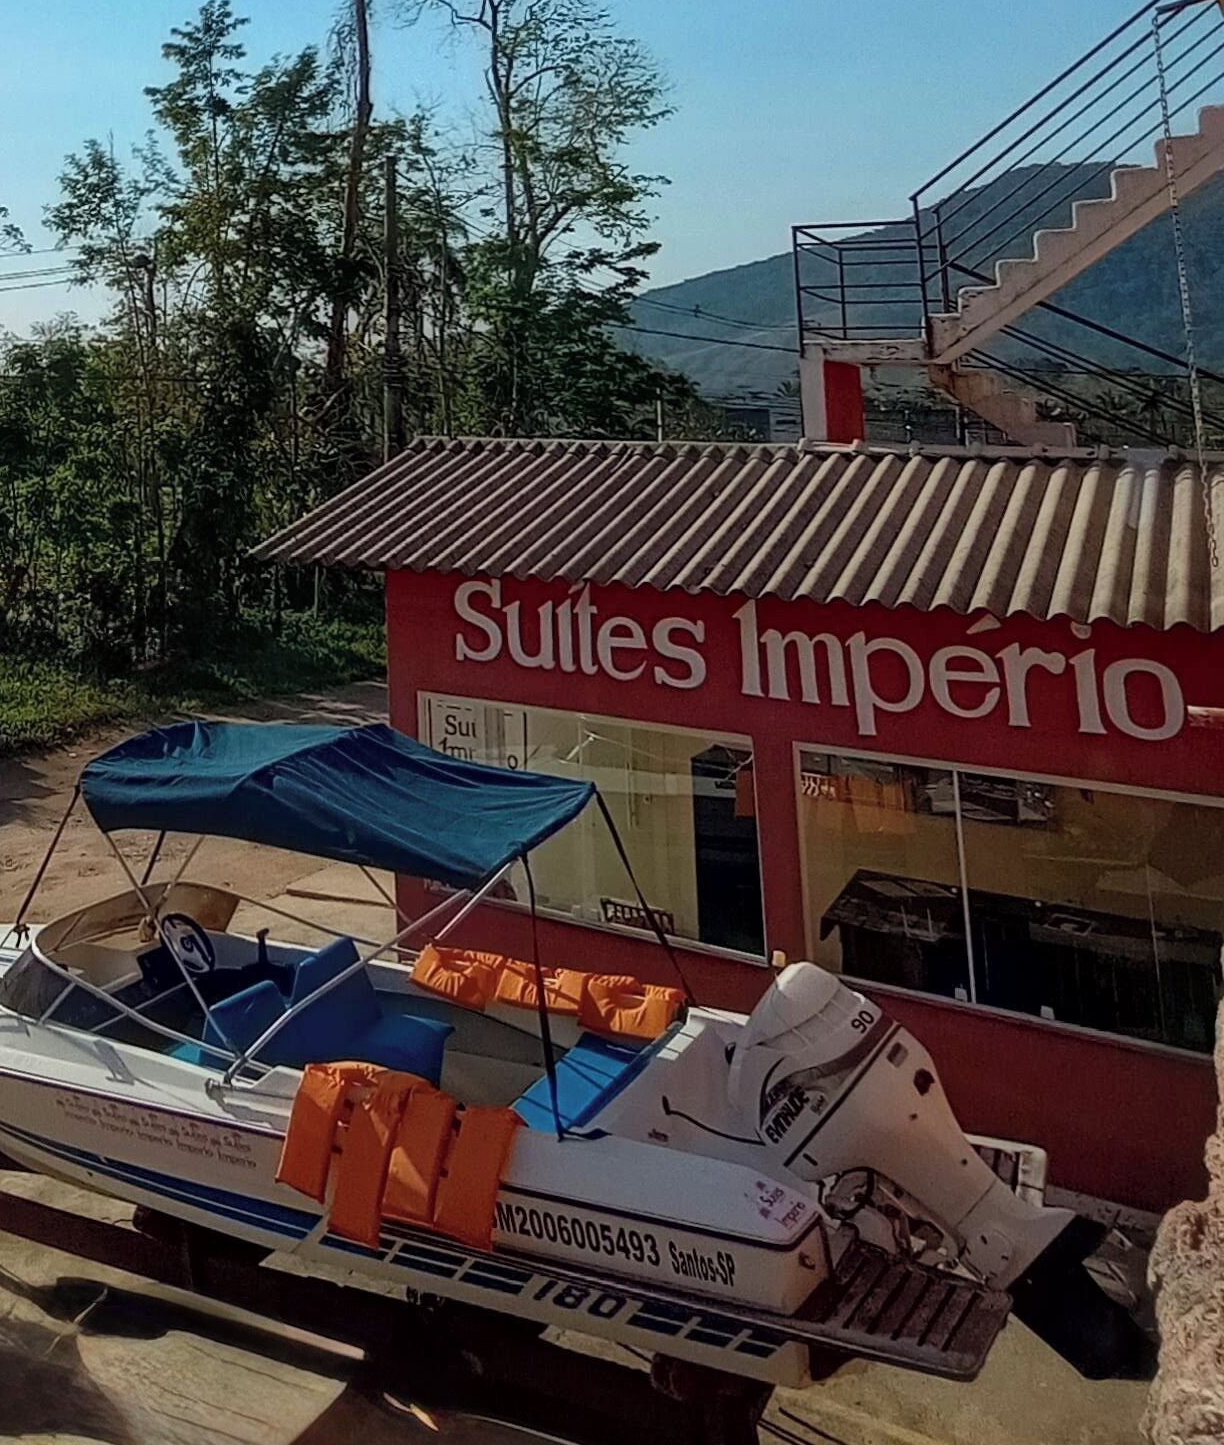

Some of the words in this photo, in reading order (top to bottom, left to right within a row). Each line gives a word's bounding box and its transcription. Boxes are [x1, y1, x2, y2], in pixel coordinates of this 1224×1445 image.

[732, 599, 1185, 740] Império
[850, 1010, 874, 1034] 90
[493, 1201, 660, 1266] M2006005493
[669, 1241, 735, 1287] Santos-SP
[532, 1279, 627, 1319] 180
